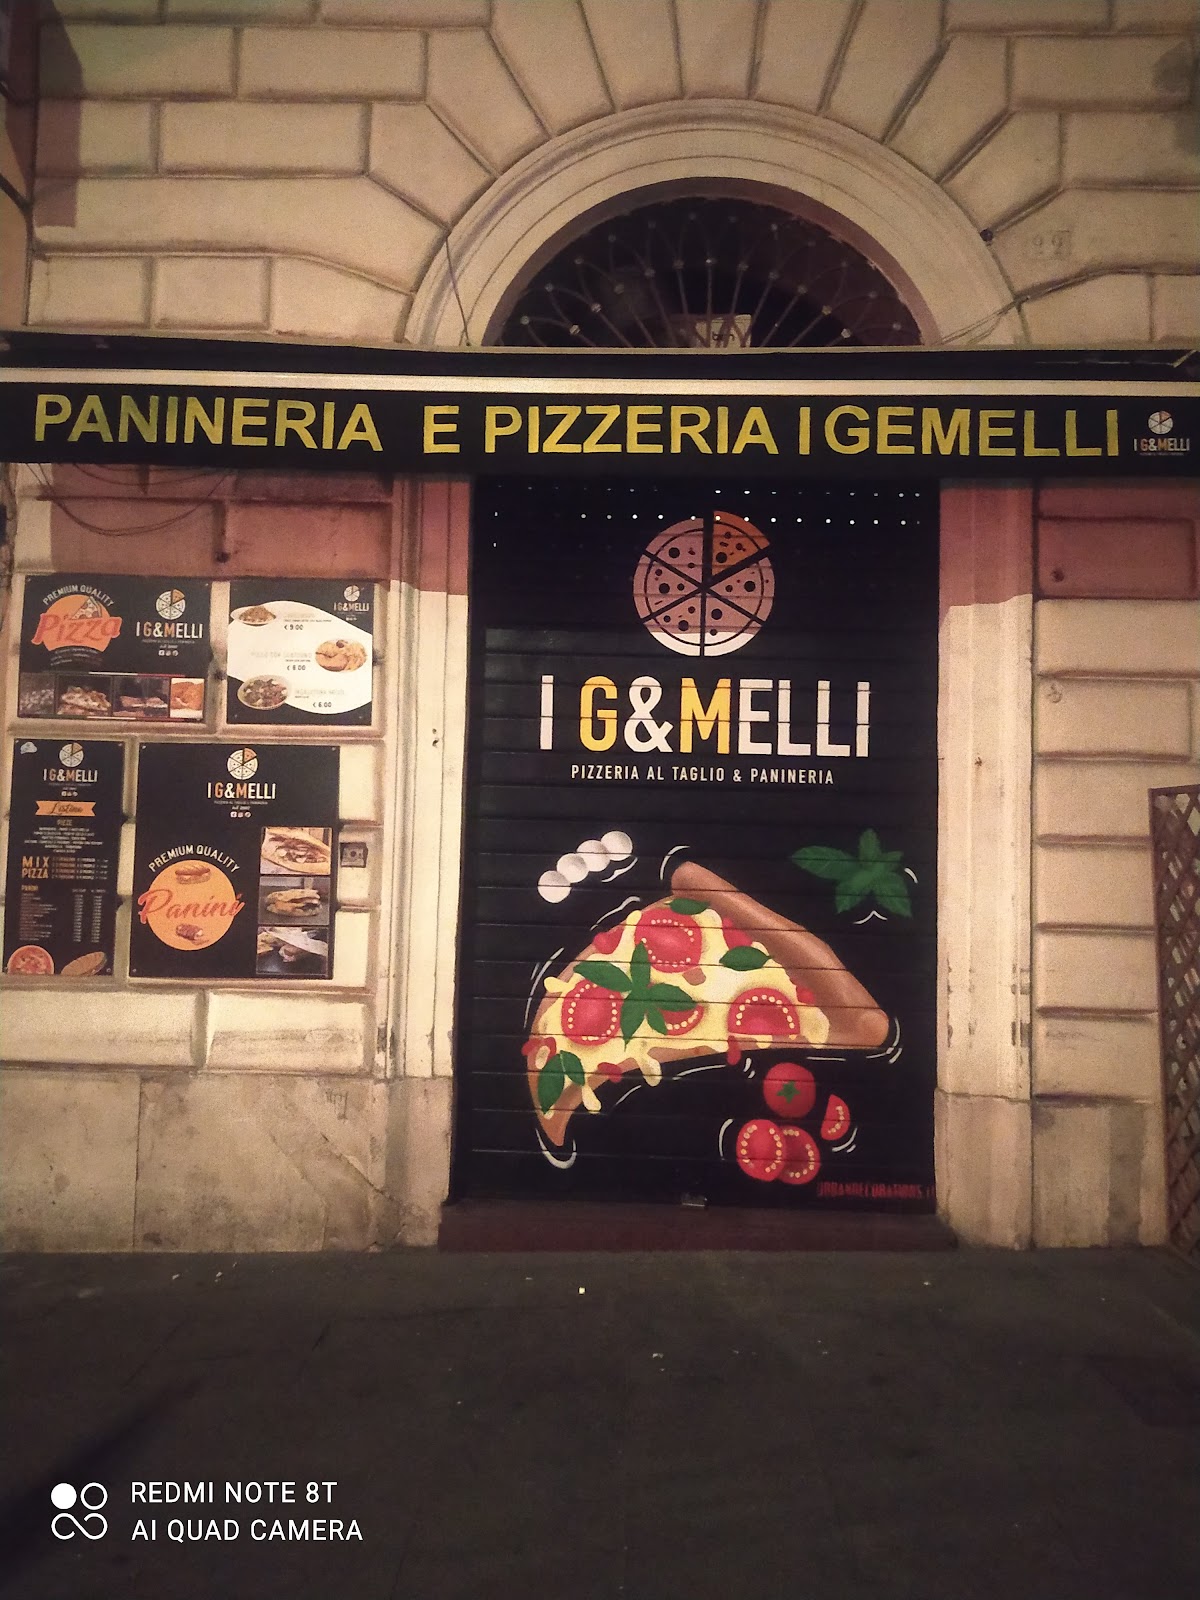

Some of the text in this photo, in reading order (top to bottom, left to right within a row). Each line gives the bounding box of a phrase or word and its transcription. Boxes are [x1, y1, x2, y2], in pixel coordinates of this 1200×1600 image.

[35, 394, 1119, 457] PANINERIA E PIZZERIA I GEMELLI
[1133, 438, 1190, 452] I G&MELLI
[43, 584, 115, 607] PREMIUM QUALITY
[31, 612, 123, 645] Pizza
[136, 621, 203, 639] I G&MELLI
[540, 675, 871, 758] I G&MELLI
[43, 769, 98, 783] I G&MELLI
[571, 764, 835, 786] PIZZERIA AL TAGLIO & PANINERIA
[207, 782, 276, 800] I G&MELLI
[148, 845, 240, 873] PREMIUM QUALITY
[21, 867, 49, 879] PIZZA
[137, 889, 246, 925] Panini
